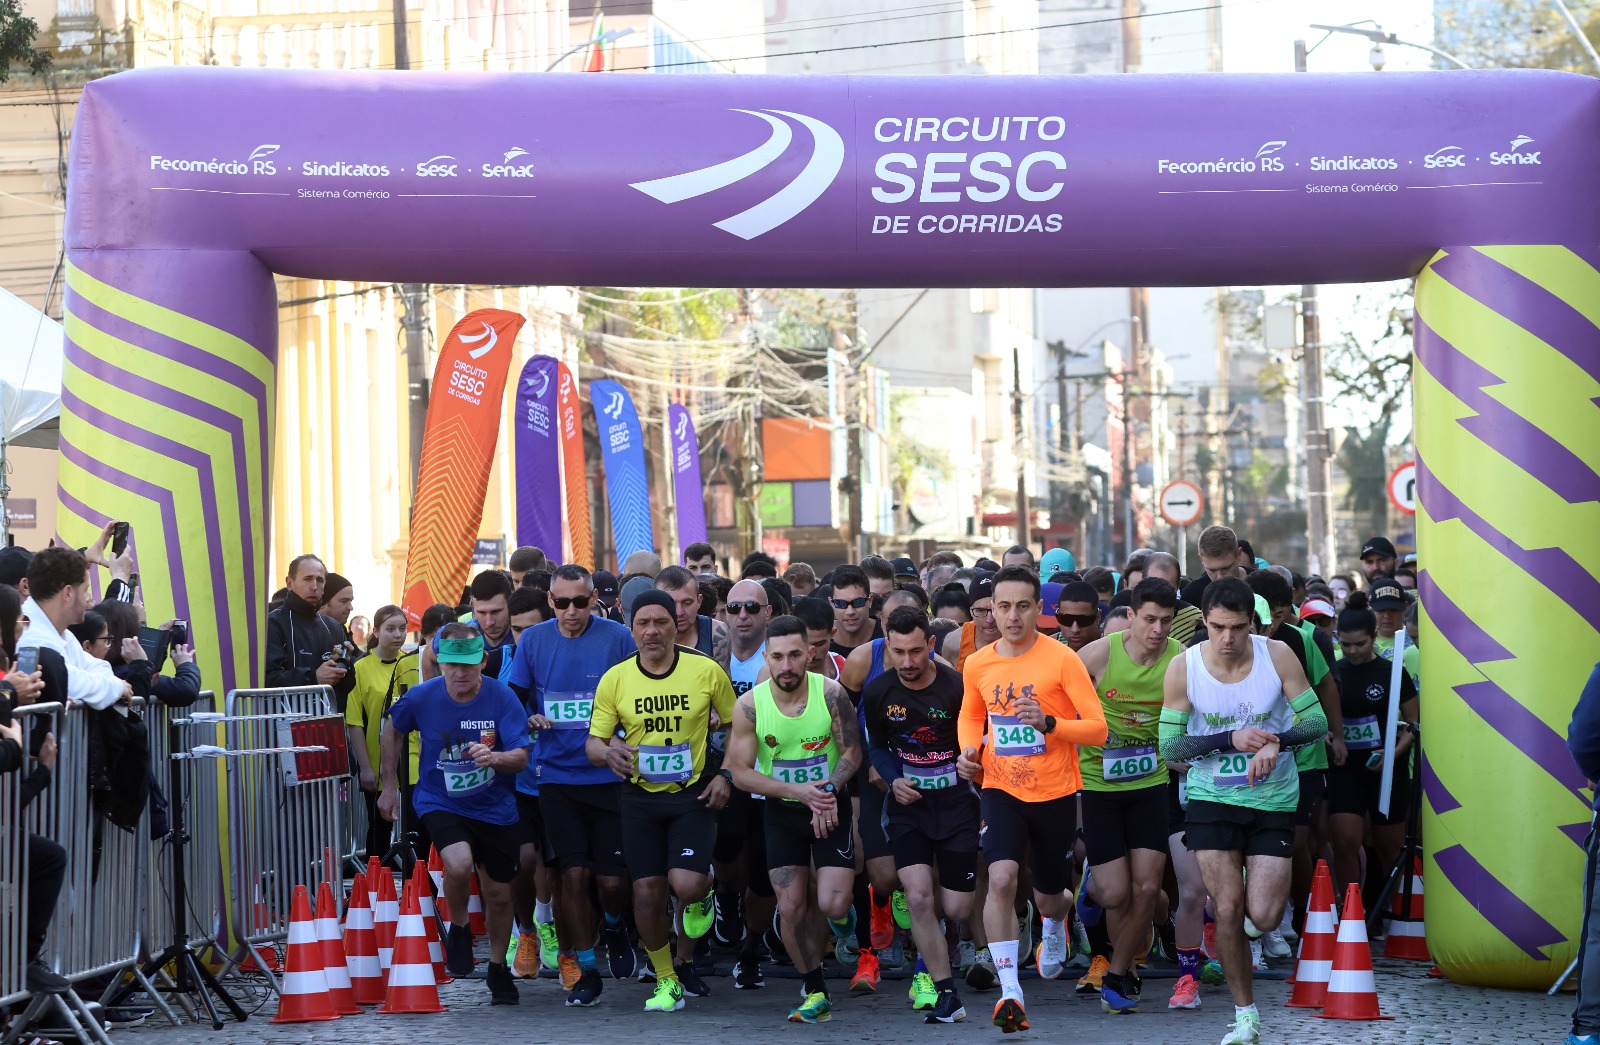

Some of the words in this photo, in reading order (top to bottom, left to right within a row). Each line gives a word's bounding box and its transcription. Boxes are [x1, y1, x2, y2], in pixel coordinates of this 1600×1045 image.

[874, 116, 1066, 142] CIRCUITO
[150, 155, 248, 175] Fecomércio
[253, 160, 277, 175] RS
[302, 161, 390, 177] Sindicatos
[416, 160, 457, 177] Sesc
[482, 162, 534, 178] Senac
[1158, 157, 1256, 174] Fecomércio
[1261, 156, 1285, 172] RS
[1309, 155, 1398, 171] Sindicatos
[1424, 151, 1466, 169] Sesc
[1490, 150, 1541, 166] Senac
[871, 151, 1067, 203] SESC
[297, 188, 340, 198] Sistema
[343, 188, 390, 199] Comércio
[1305, 183, 1348, 193] Sistema
[1351, 182, 1398, 192] Comércio
[871, 215, 911, 234] DE
[917, 213, 1063, 234] CORRIDAS
[453, 359, 488, 380] CIRCUITO
[450, 370, 485, 396] SESC
[455, 390, 481, 406] CORRIDAS
[528, 408, 550, 430] SESC
[609, 429, 630, 447] SESC
[1375, 586, 1400, 599] TIGERS
[550, 701, 591, 720] 155
[635, 694, 690, 715] EQUIPE
[460, 719, 495, 730] RÚSTICA
[644, 715, 683, 733] BOLT
[1344, 724, 1374, 741] 234
[997, 726, 1037, 745] 348
[645, 753, 685, 772] 173
[1109, 756, 1153, 776] 460
[450, 767, 489, 790] 227
[779, 766, 824, 784] 183
